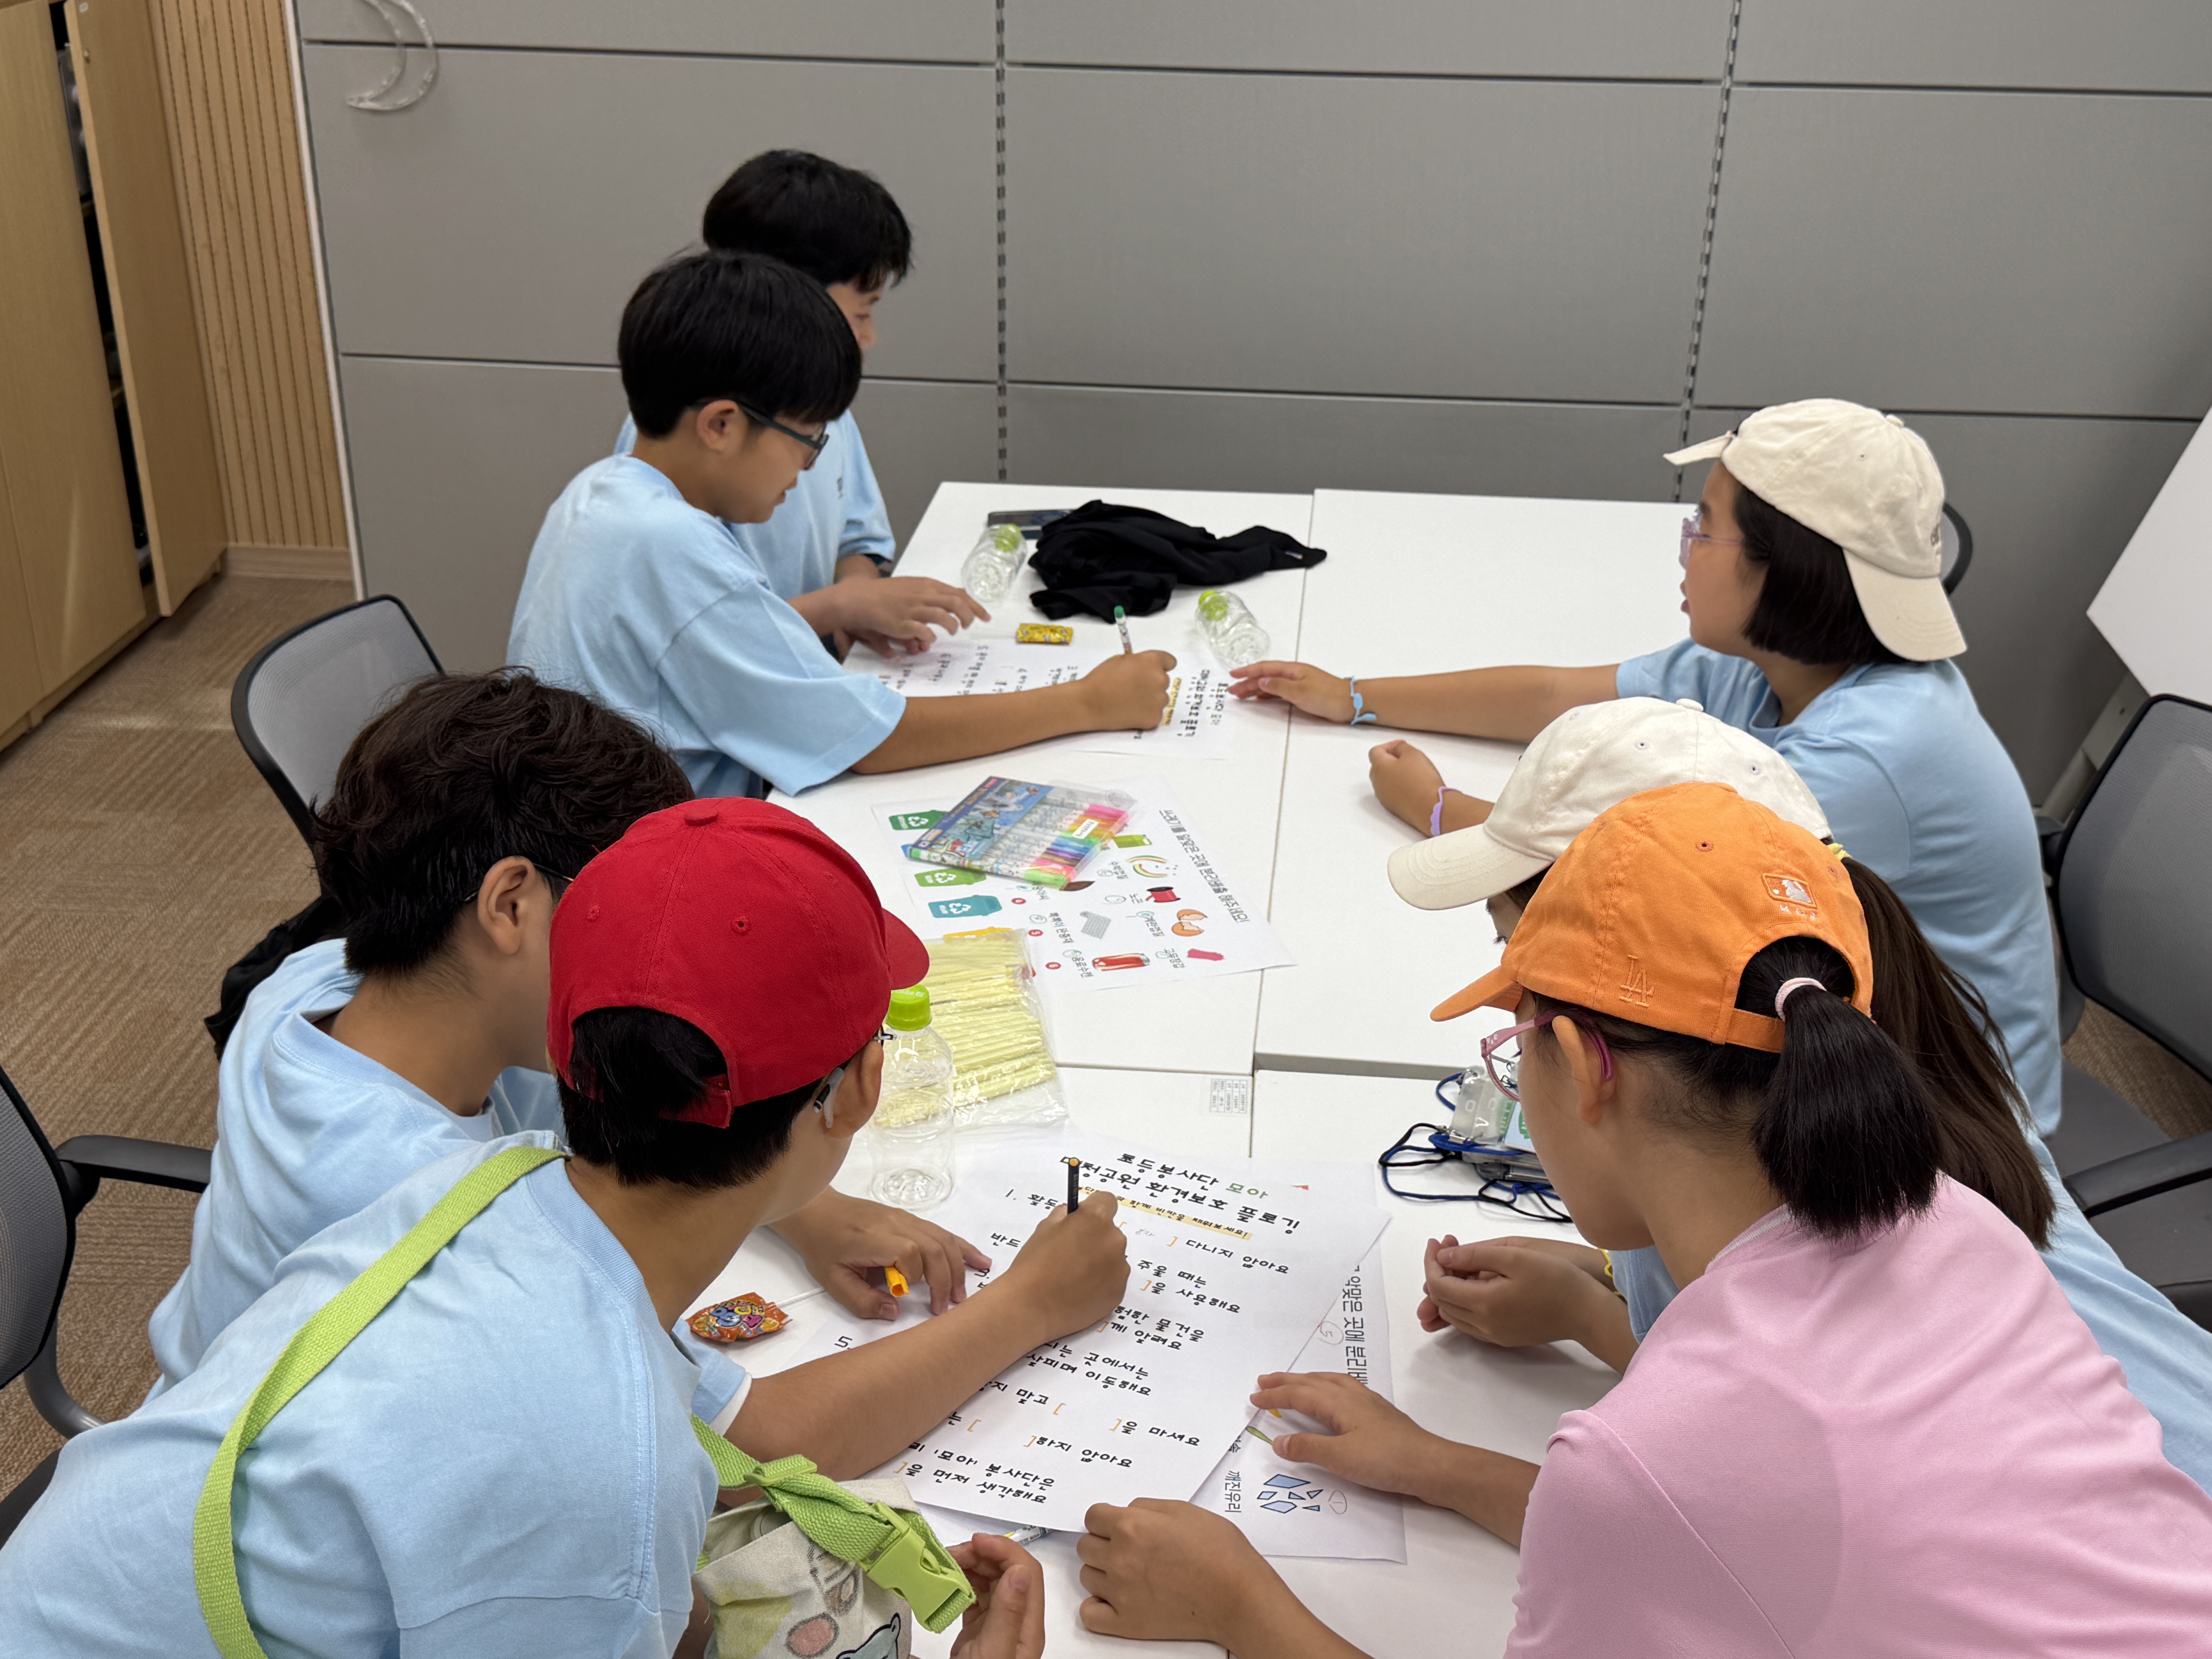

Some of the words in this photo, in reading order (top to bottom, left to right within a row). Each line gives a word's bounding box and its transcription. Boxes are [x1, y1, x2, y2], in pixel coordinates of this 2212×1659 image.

[1619, 955, 1655, 1007] LA
[1117, 1153, 1219, 1191] 초등봉사단
[1226, 1183, 1268, 1199] 모아
[1145, 1182, 1228, 1210] 환경보호
[1237, 1206, 1300, 1234] 플로깅
[1156, 1207, 1185, 1221] 빈칸을
[1192, 1217, 1248, 1239] 채워보세요!
[1185, 1240, 1233, 1258] 다니지
[1243, 1256, 1289, 1274] 않아요
[1178, 1271, 1206, 1288] 때는
[1176, 1289, 1240, 1313] 사용해요
[1135, 1330, 1182, 1350] 알려요
[1156, 1319, 1204, 1342] 물건을
[1344, 1317, 1365, 1342] 곳에
[1025, 1354, 1077, 1373] 살피며
[1085, 1371, 1151, 1396] 이동해요
[1084, 1352, 1149, 1380] 곳에서는
[1016, 1389, 1049, 1405] 말고
[1149, 1427, 1200, 1446] 마셔요
[1081, 1449, 1132, 1467] 않아요
[933, 1470, 970, 1484] 먼저
[976, 1482, 1046, 1503] 생각해요
[986, 1464, 1054, 1490] 봉사단은
[1224, 1470, 1242, 1513] 깨진유리
